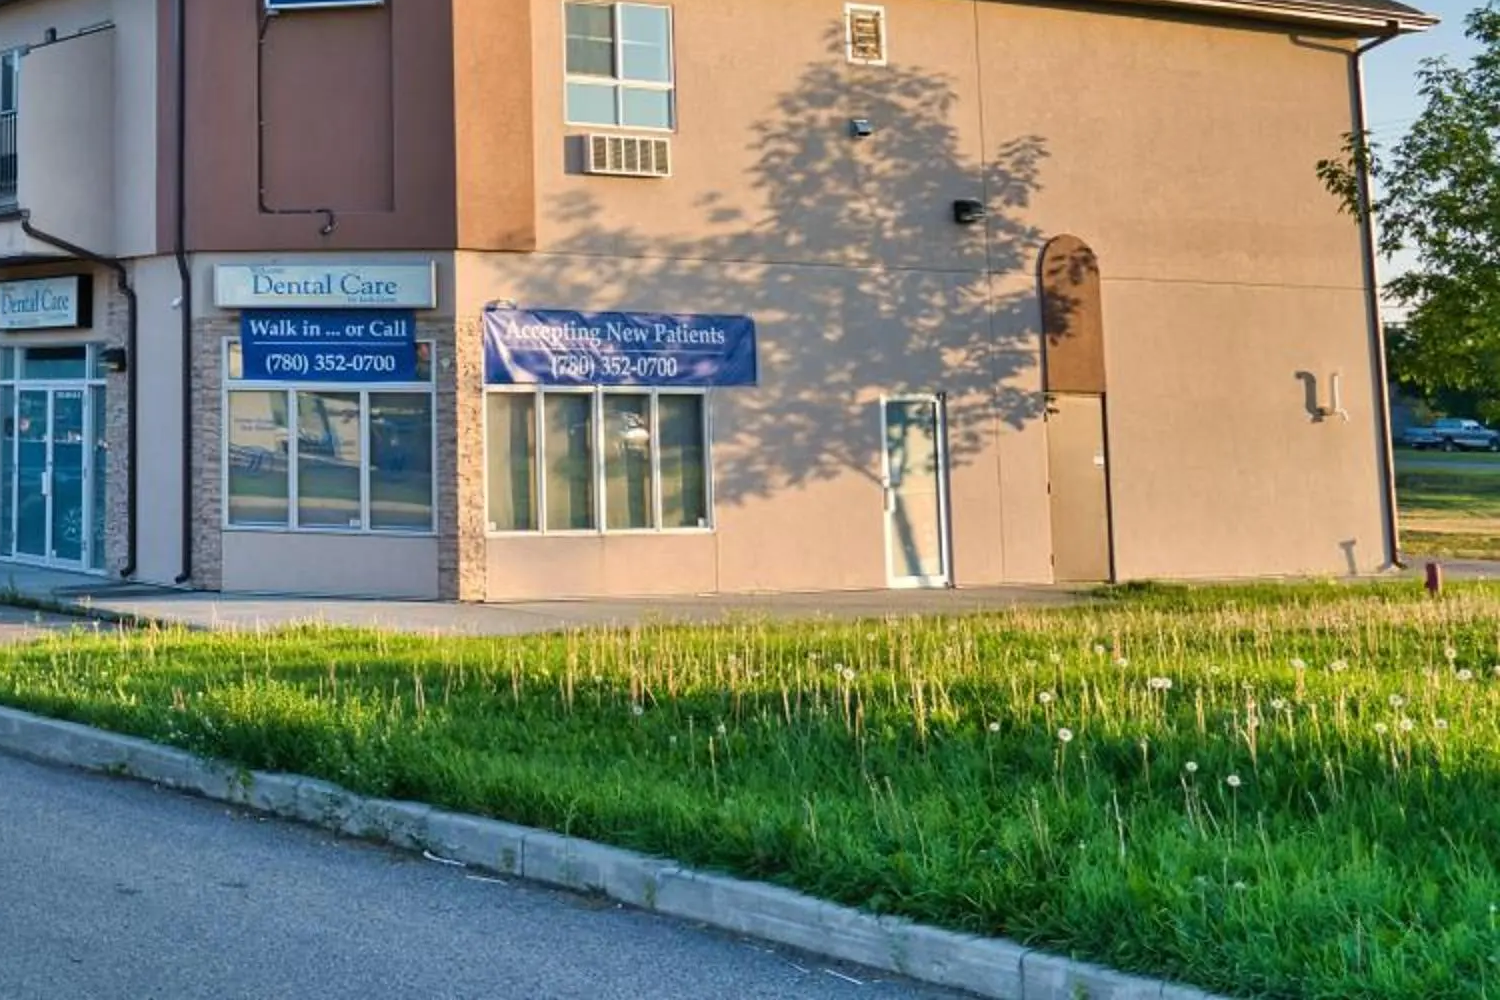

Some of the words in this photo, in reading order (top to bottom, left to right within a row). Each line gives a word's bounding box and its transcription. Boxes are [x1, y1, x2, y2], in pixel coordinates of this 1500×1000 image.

[252, 274, 332, 296] Dental
[339, 273, 398, 296] Care
[1, 288, 40, 314] Dental
[41, 288, 70, 312] Care
[249, 319, 298, 337] Walk
[302, 320, 321, 337] in
[345, 323, 364, 337] or
[369, 319, 408, 338] Call
[504, 320, 601, 348] Accepting
[606, 322, 648, 343] New
[654, 322, 726, 345] Patients
[265, 353, 309, 375] (780)
[313, 354, 396, 372] 352-0700
[551, 355, 595, 378] (780)
[600, 356, 678, 377] 352-0700
